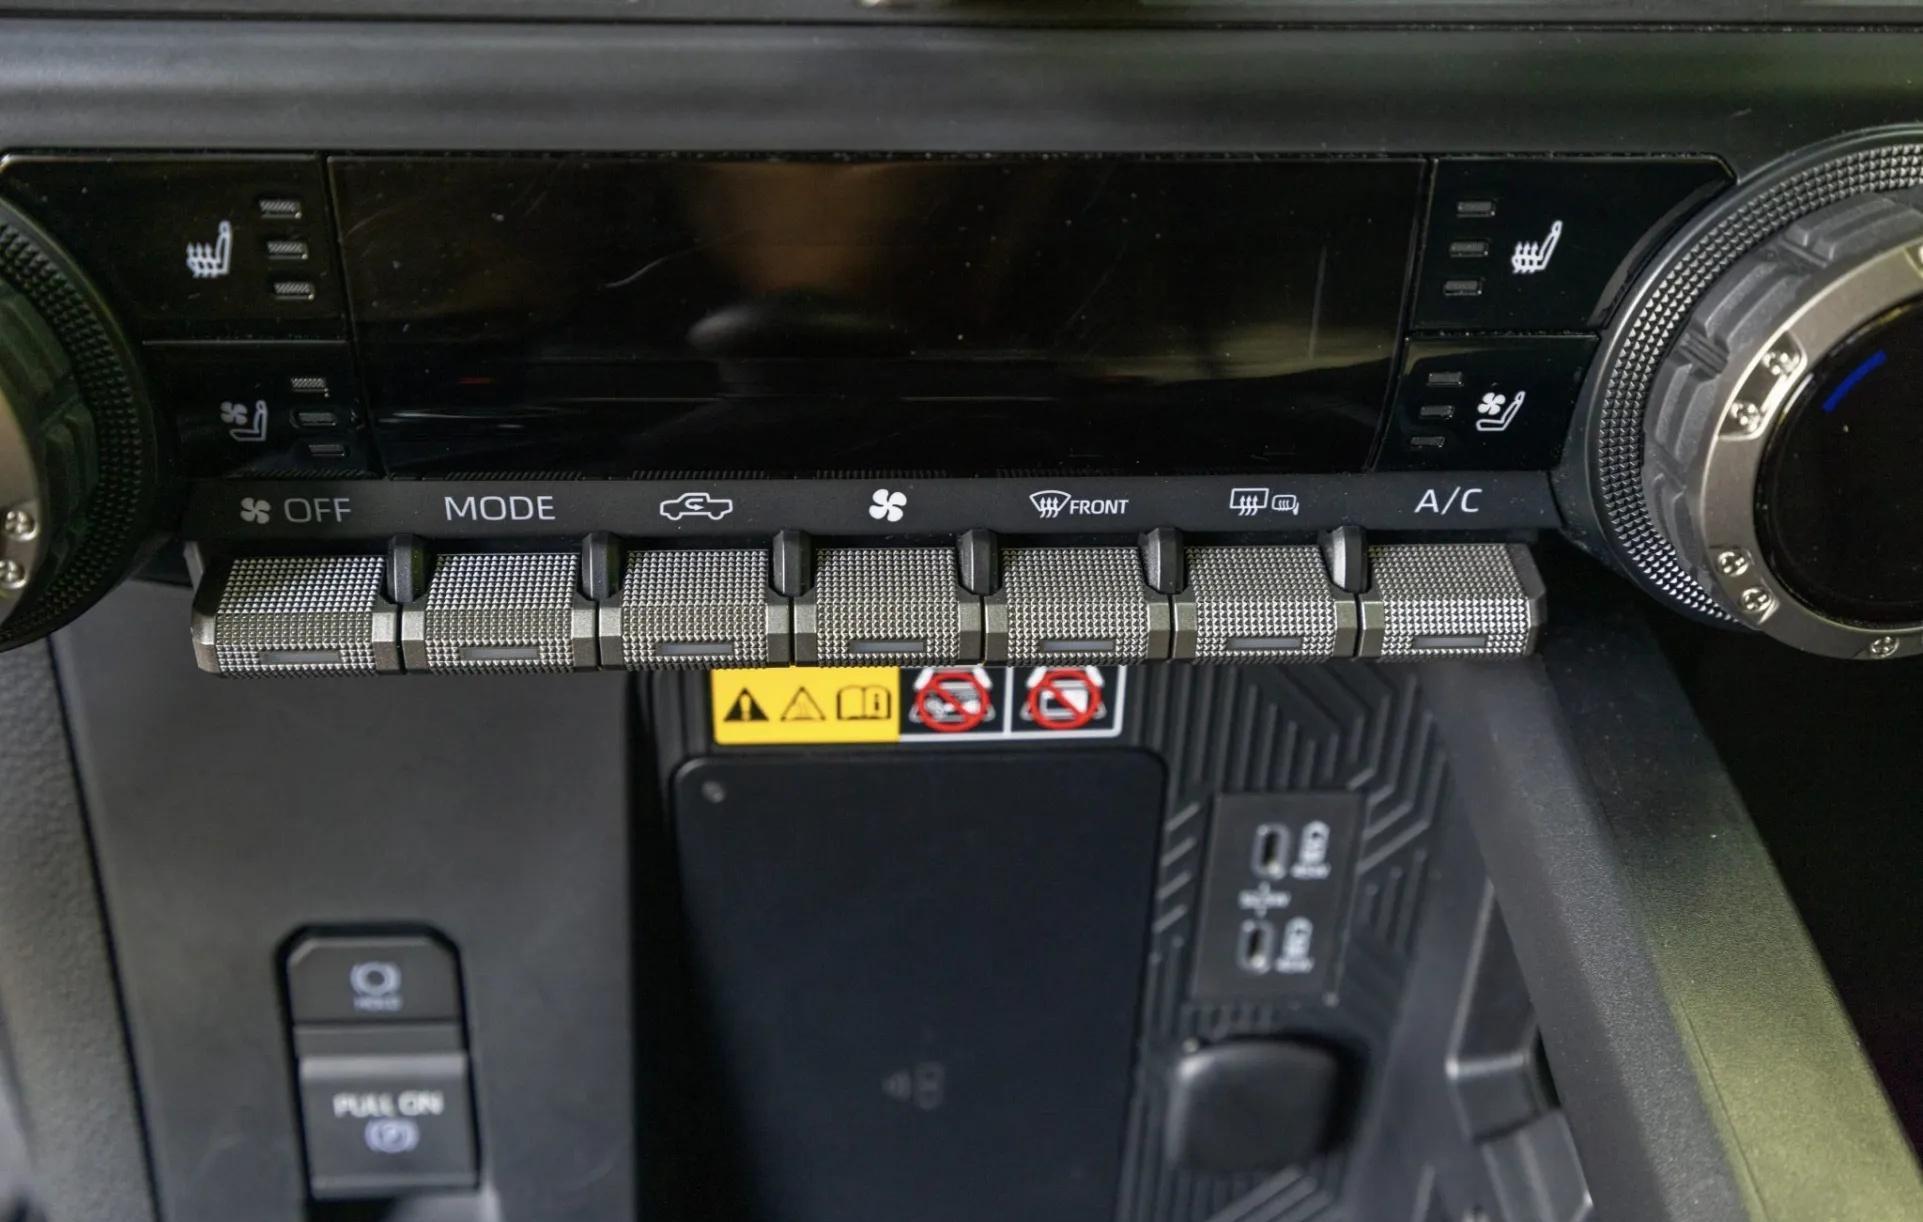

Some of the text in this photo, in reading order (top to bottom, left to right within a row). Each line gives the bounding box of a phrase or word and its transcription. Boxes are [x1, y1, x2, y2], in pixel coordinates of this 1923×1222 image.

[284, 496, 352, 523] OFF
[444, 495, 556, 522] MODE
[1069, 499, 1130, 515] FRONT
[1414, 486, 1483, 516] A/C
[332, 1089, 444, 1118] PULL ON
